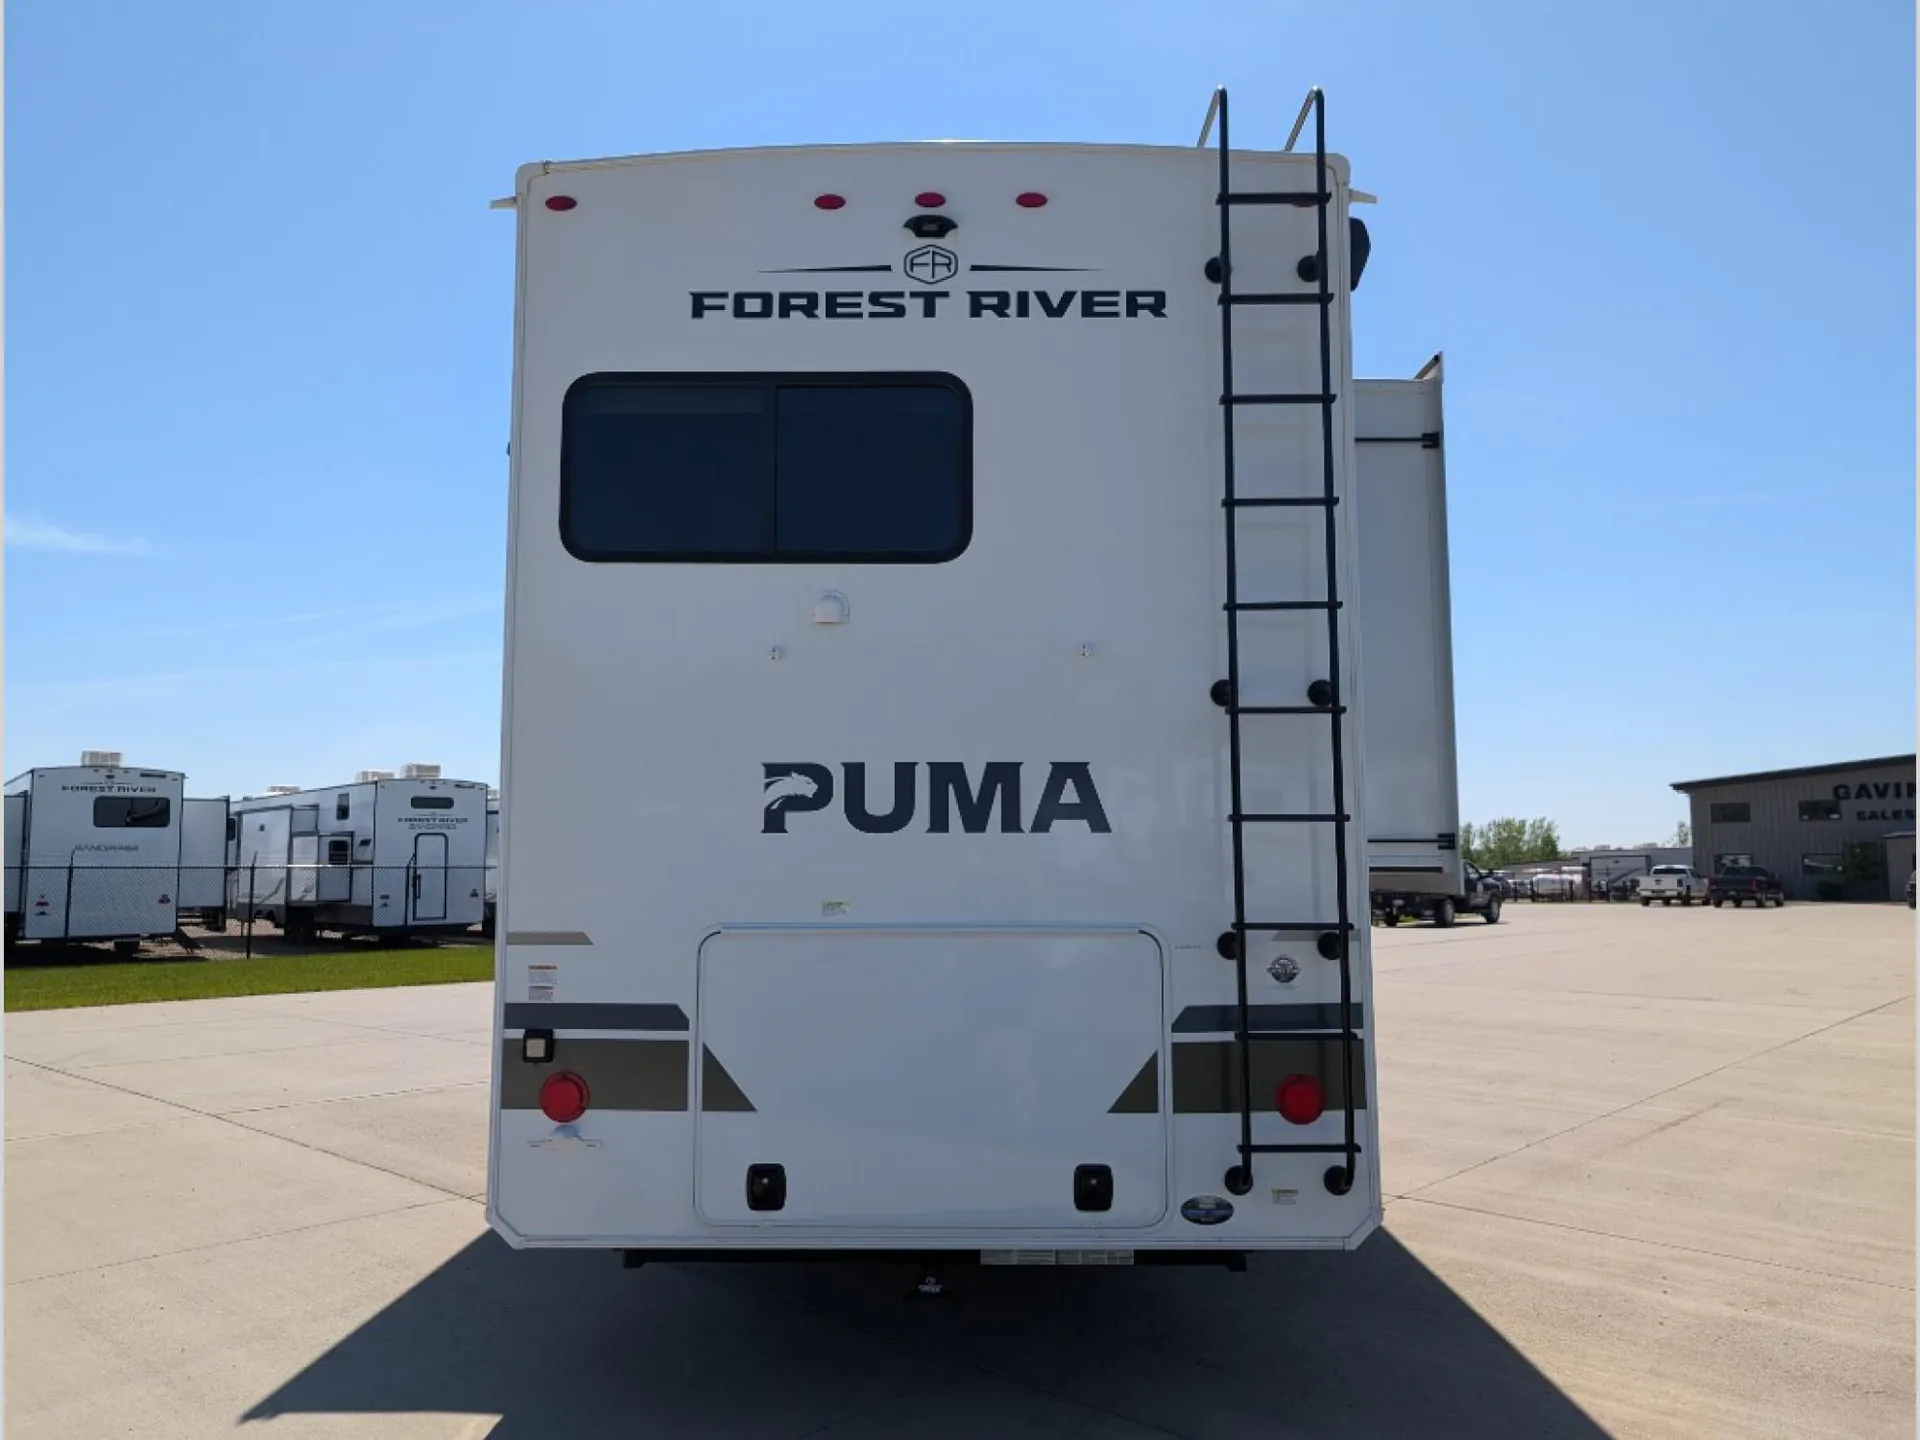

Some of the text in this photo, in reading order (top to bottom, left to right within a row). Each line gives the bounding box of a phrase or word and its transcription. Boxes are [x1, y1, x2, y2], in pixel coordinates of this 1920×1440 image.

[908, 248, 953, 280] FR
[689, 290, 1168, 319] FOREST RIVER
[61, 785, 156, 793] FOREST RIVER
[761, 761, 1112, 833] PUMA
